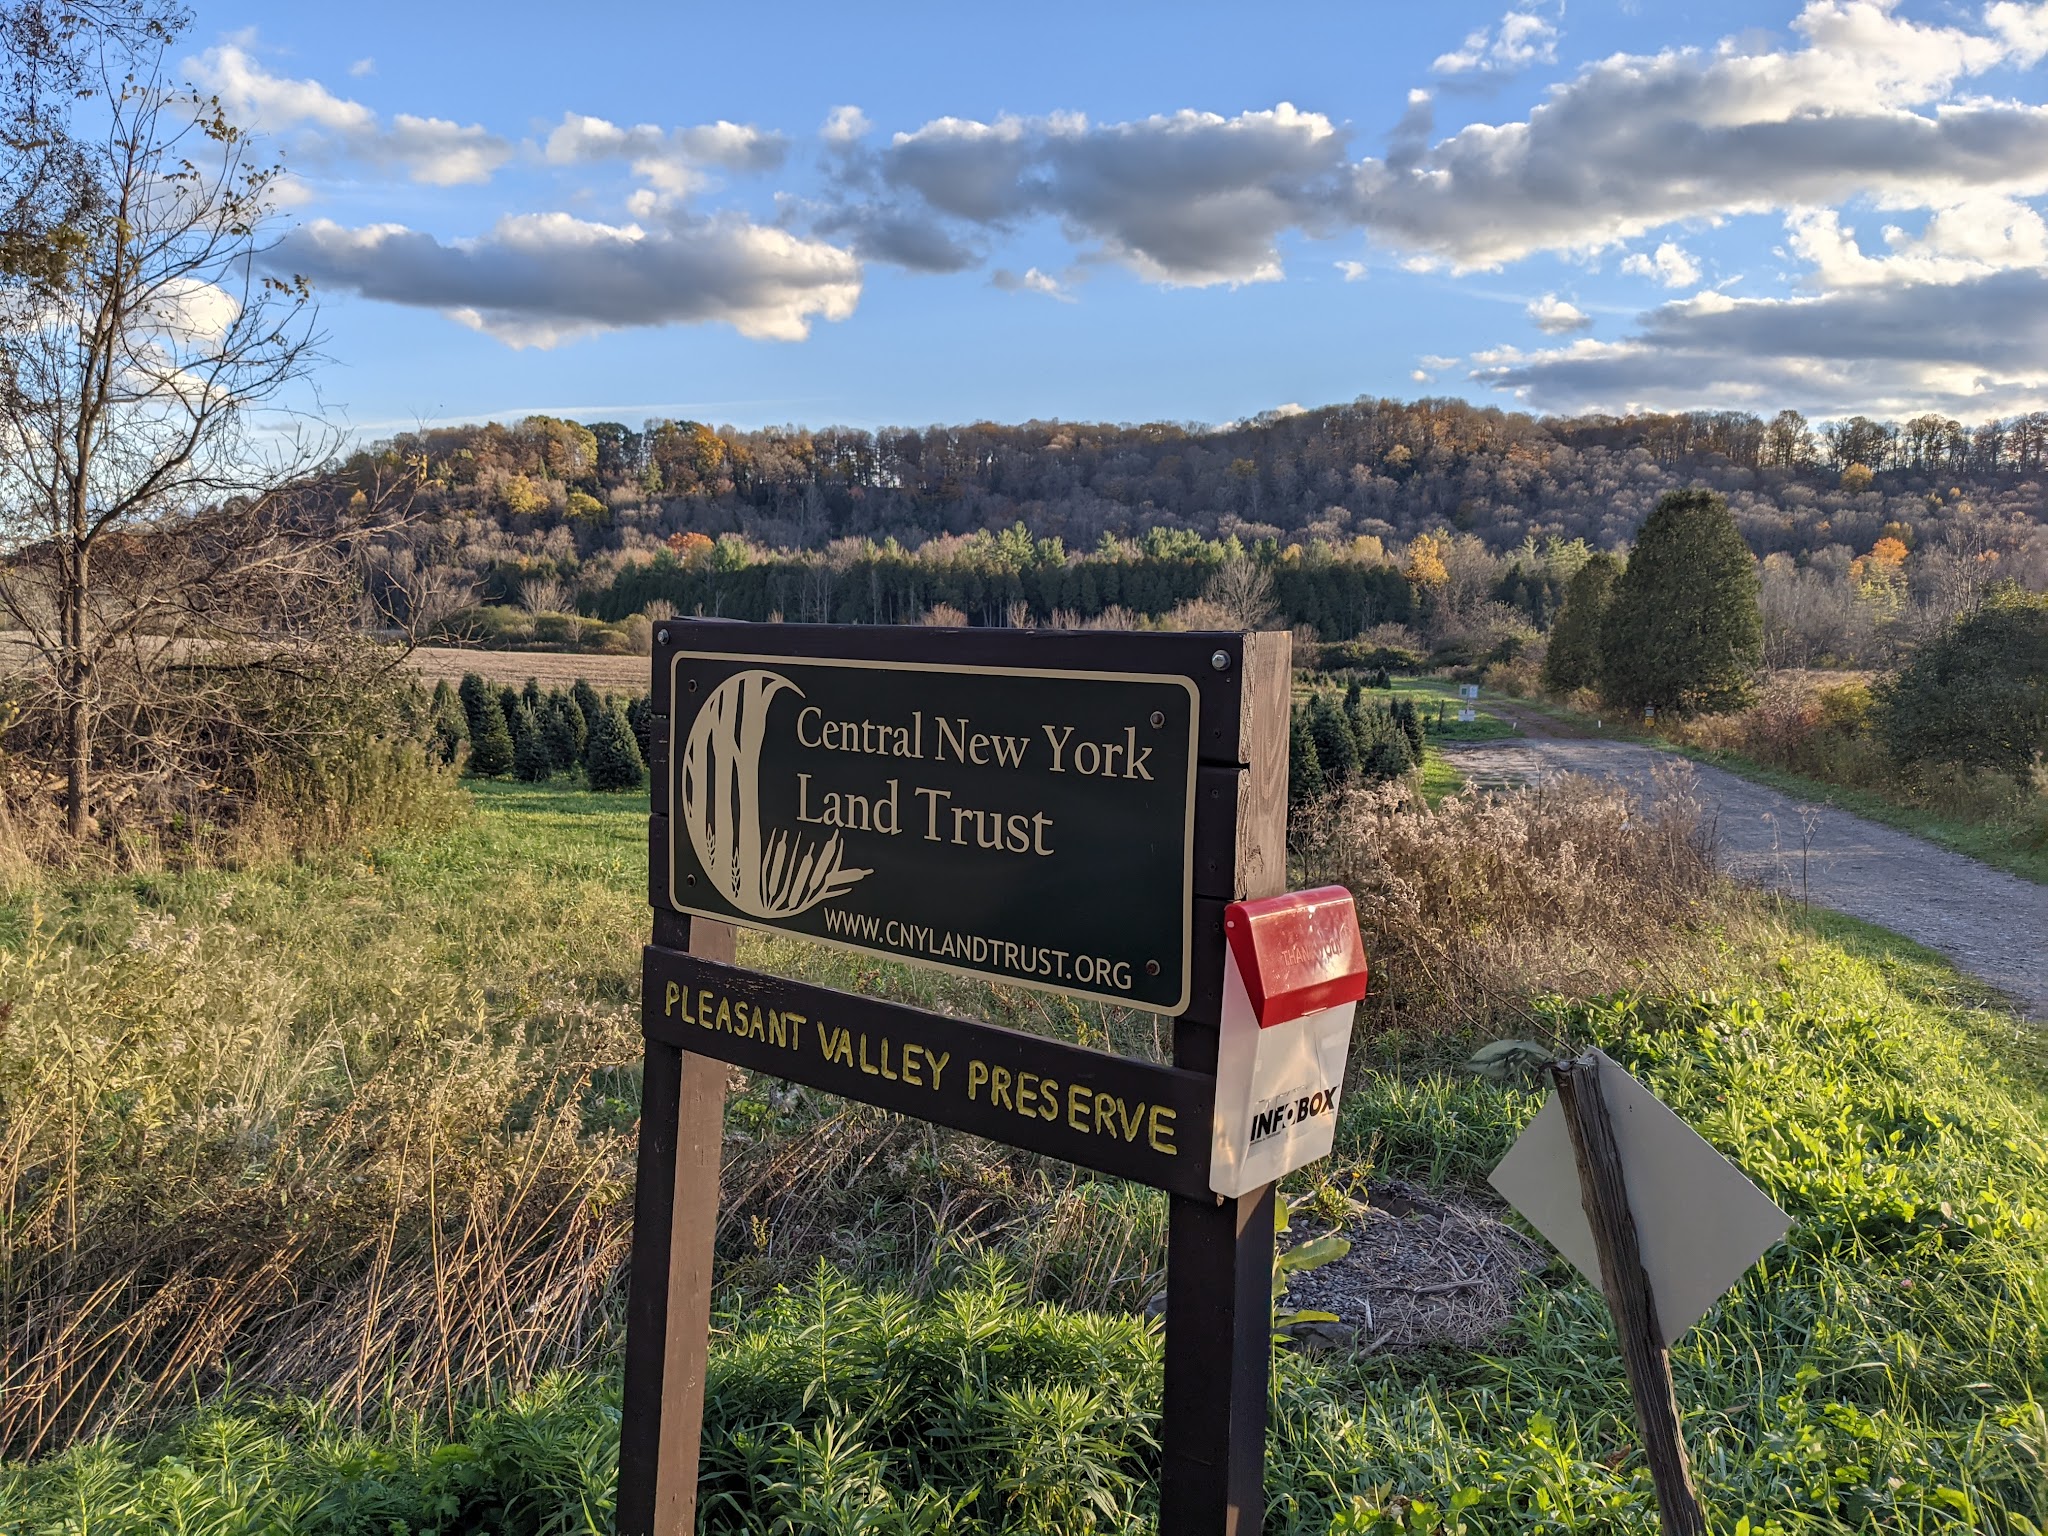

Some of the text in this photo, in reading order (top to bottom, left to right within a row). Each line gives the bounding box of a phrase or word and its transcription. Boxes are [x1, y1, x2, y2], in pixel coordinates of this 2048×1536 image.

[797, 706, 1154, 781] Central New York
[797, 773, 1055, 857] Land Trust
[823, 907, 1132, 990] WWW.CNYLANDTRUST.ORG
[664, 980, 1178, 1155] PLEASANT VALLEY PRESERVE
